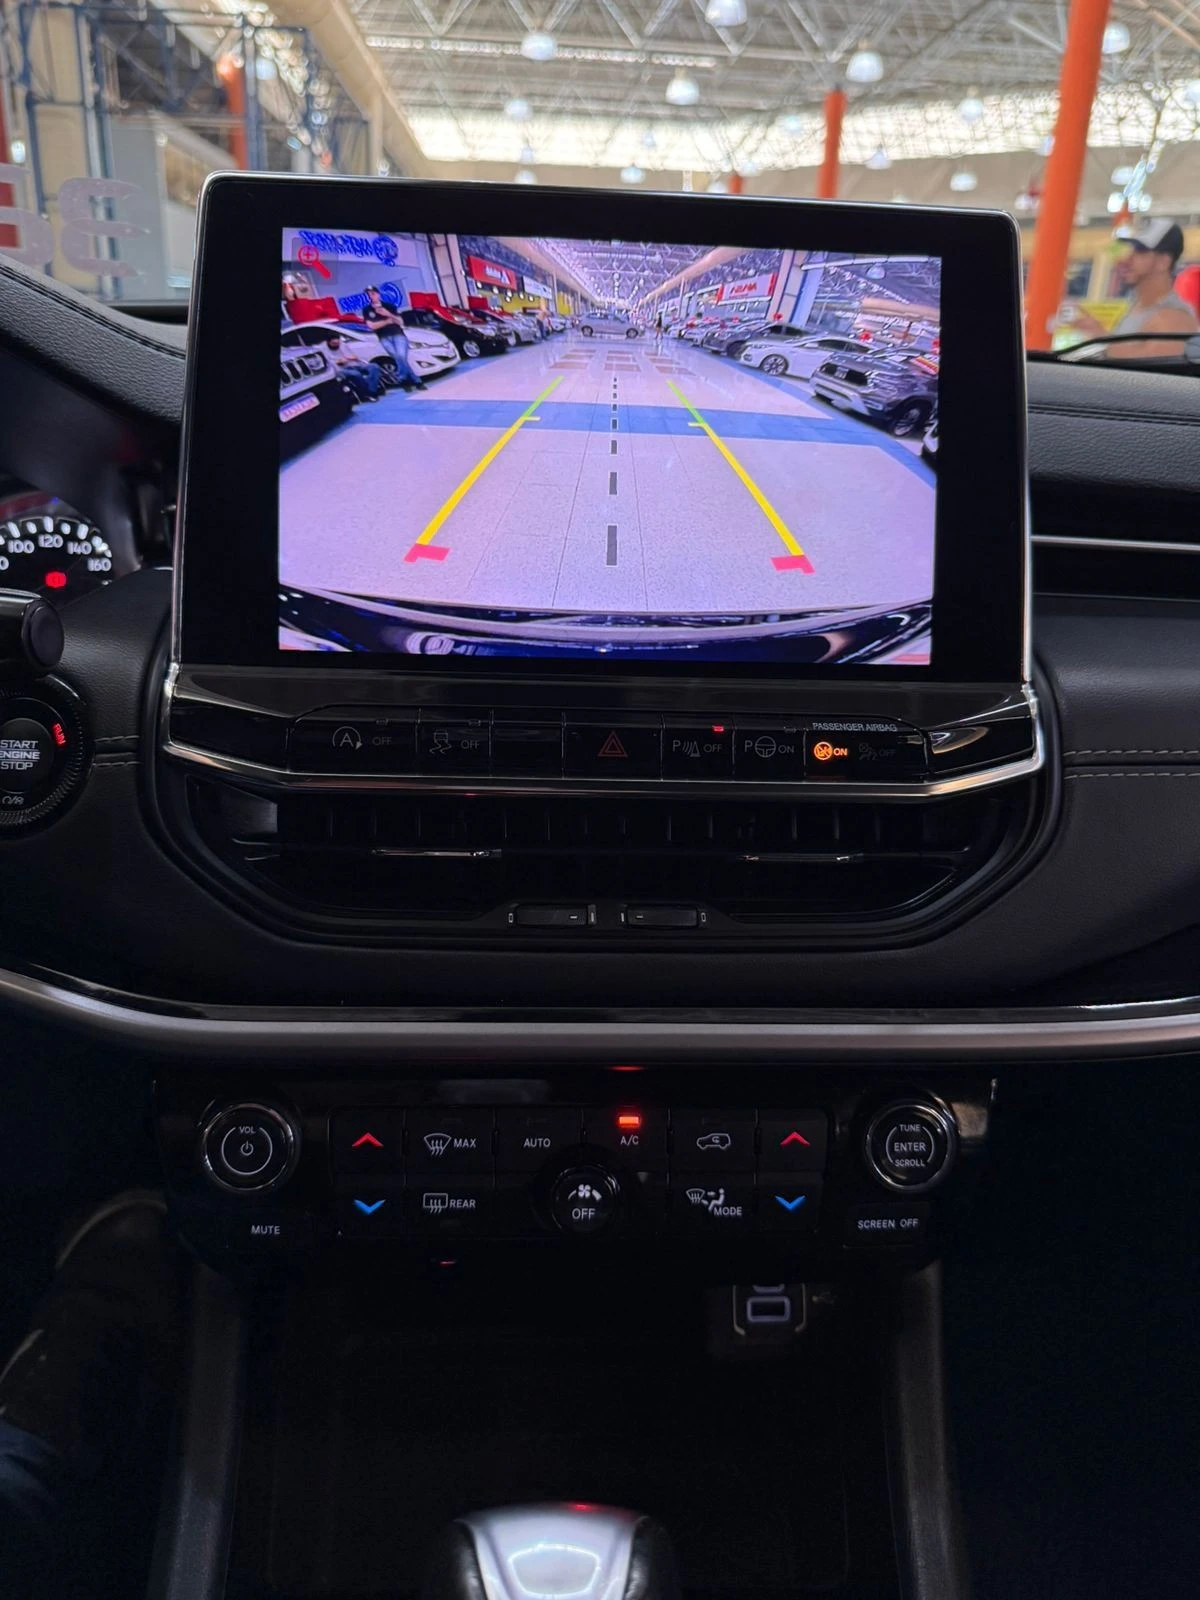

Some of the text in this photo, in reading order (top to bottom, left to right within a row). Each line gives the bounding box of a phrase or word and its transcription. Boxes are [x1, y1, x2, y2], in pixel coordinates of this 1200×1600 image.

[8, 539, 35, 554] 100
[38, 533, 64, 548] 120
[67, 541, 92, 555] 140
[87, 557, 112, 572] 160
[812, 722, 898, 732] PASSENGER AIRBAG
[52, 722, 67, 745] RUN
[0, 739, 39, 749] START
[372, 736, 393, 746] OFF
[460, 739, 480, 750] OFF
[703, 743, 723, 753] OFF
[777, 744, 795, 754] ON
[833, 748, 848, 757] ON
[0, 761, 34, 770] STOP
[239, 1125, 256, 1135] VOL
[900, 1124, 921, 1133] TUNE
[454, 1137, 477, 1149] MAX
[523, 1137, 551, 1149] AUTO
[620, 1134, 640, 1146] A/C
[893, 1141, 926, 1153] ENTER
[894, 1158, 926, 1168] SCROLL
[450, 1198, 476, 1209] REAR
[571, 1207, 596, 1221] OFF
[713, 1205, 743, 1217] MODE
[251, 1224, 281, 1236] MUTE
[857, 1218, 919, 1230] SCREEN OFF
